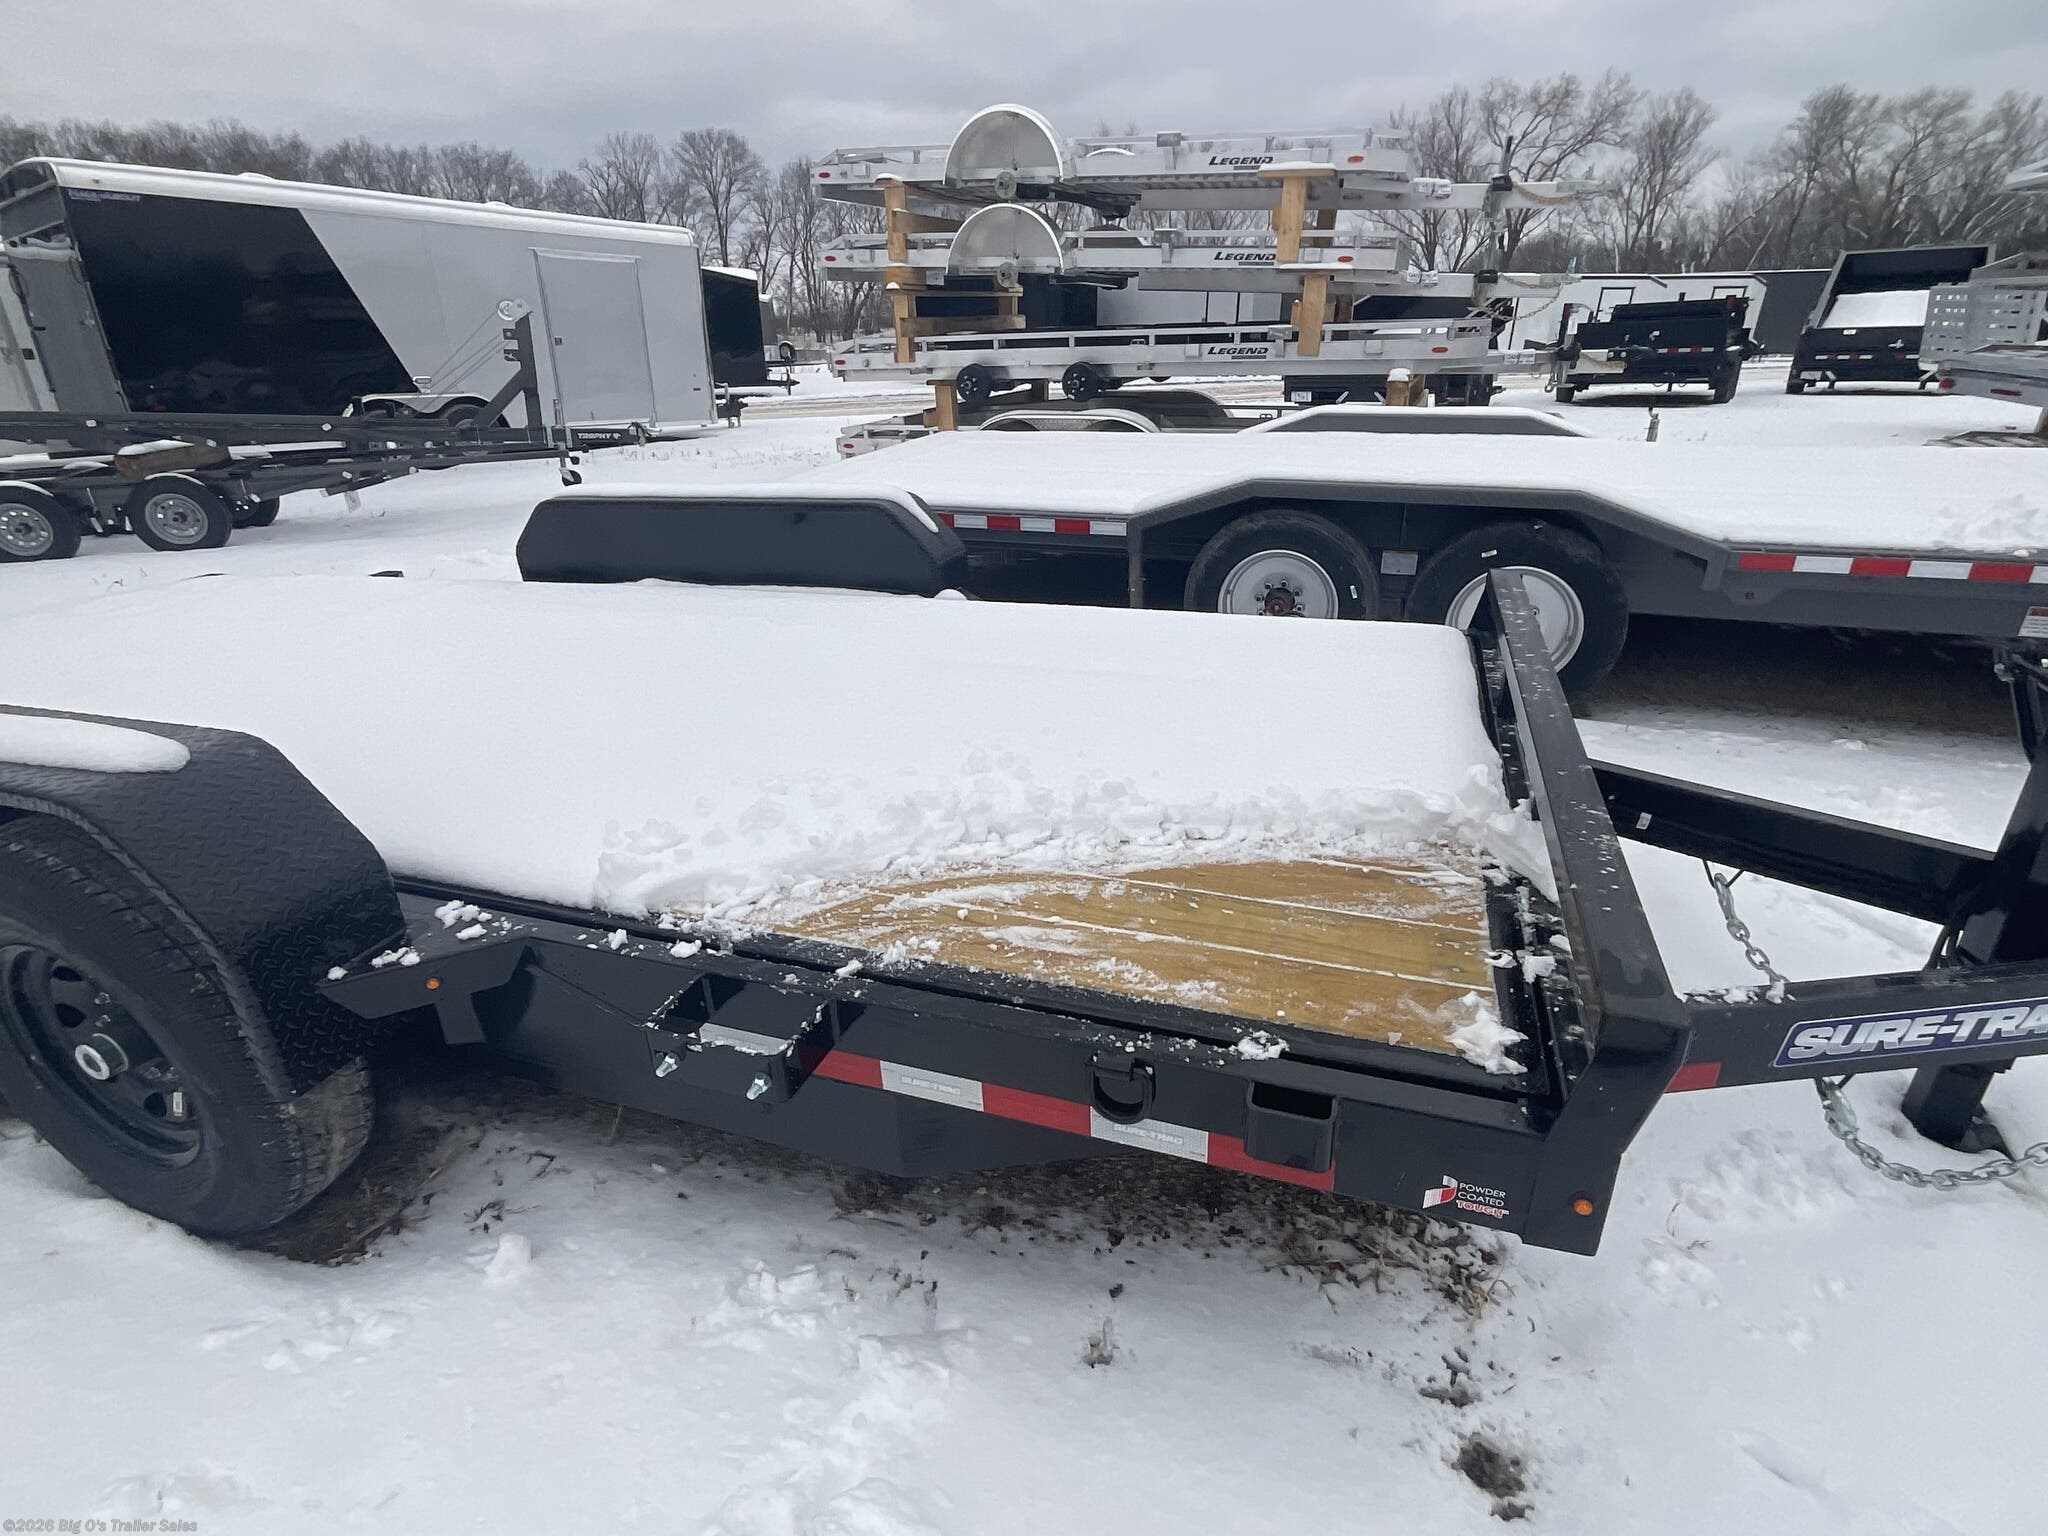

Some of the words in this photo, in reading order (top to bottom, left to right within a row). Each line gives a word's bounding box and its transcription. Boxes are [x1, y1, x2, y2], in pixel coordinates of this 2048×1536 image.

[1209, 156, 1274, 166] LEGEND
[1214, 251, 1277, 261] LEGEND
[1207, 346, 1269, 355] LEGEND
[1459, 1182, 1506, 1199] POWDER
[1457, 1191, 1504, 1207] COATED
